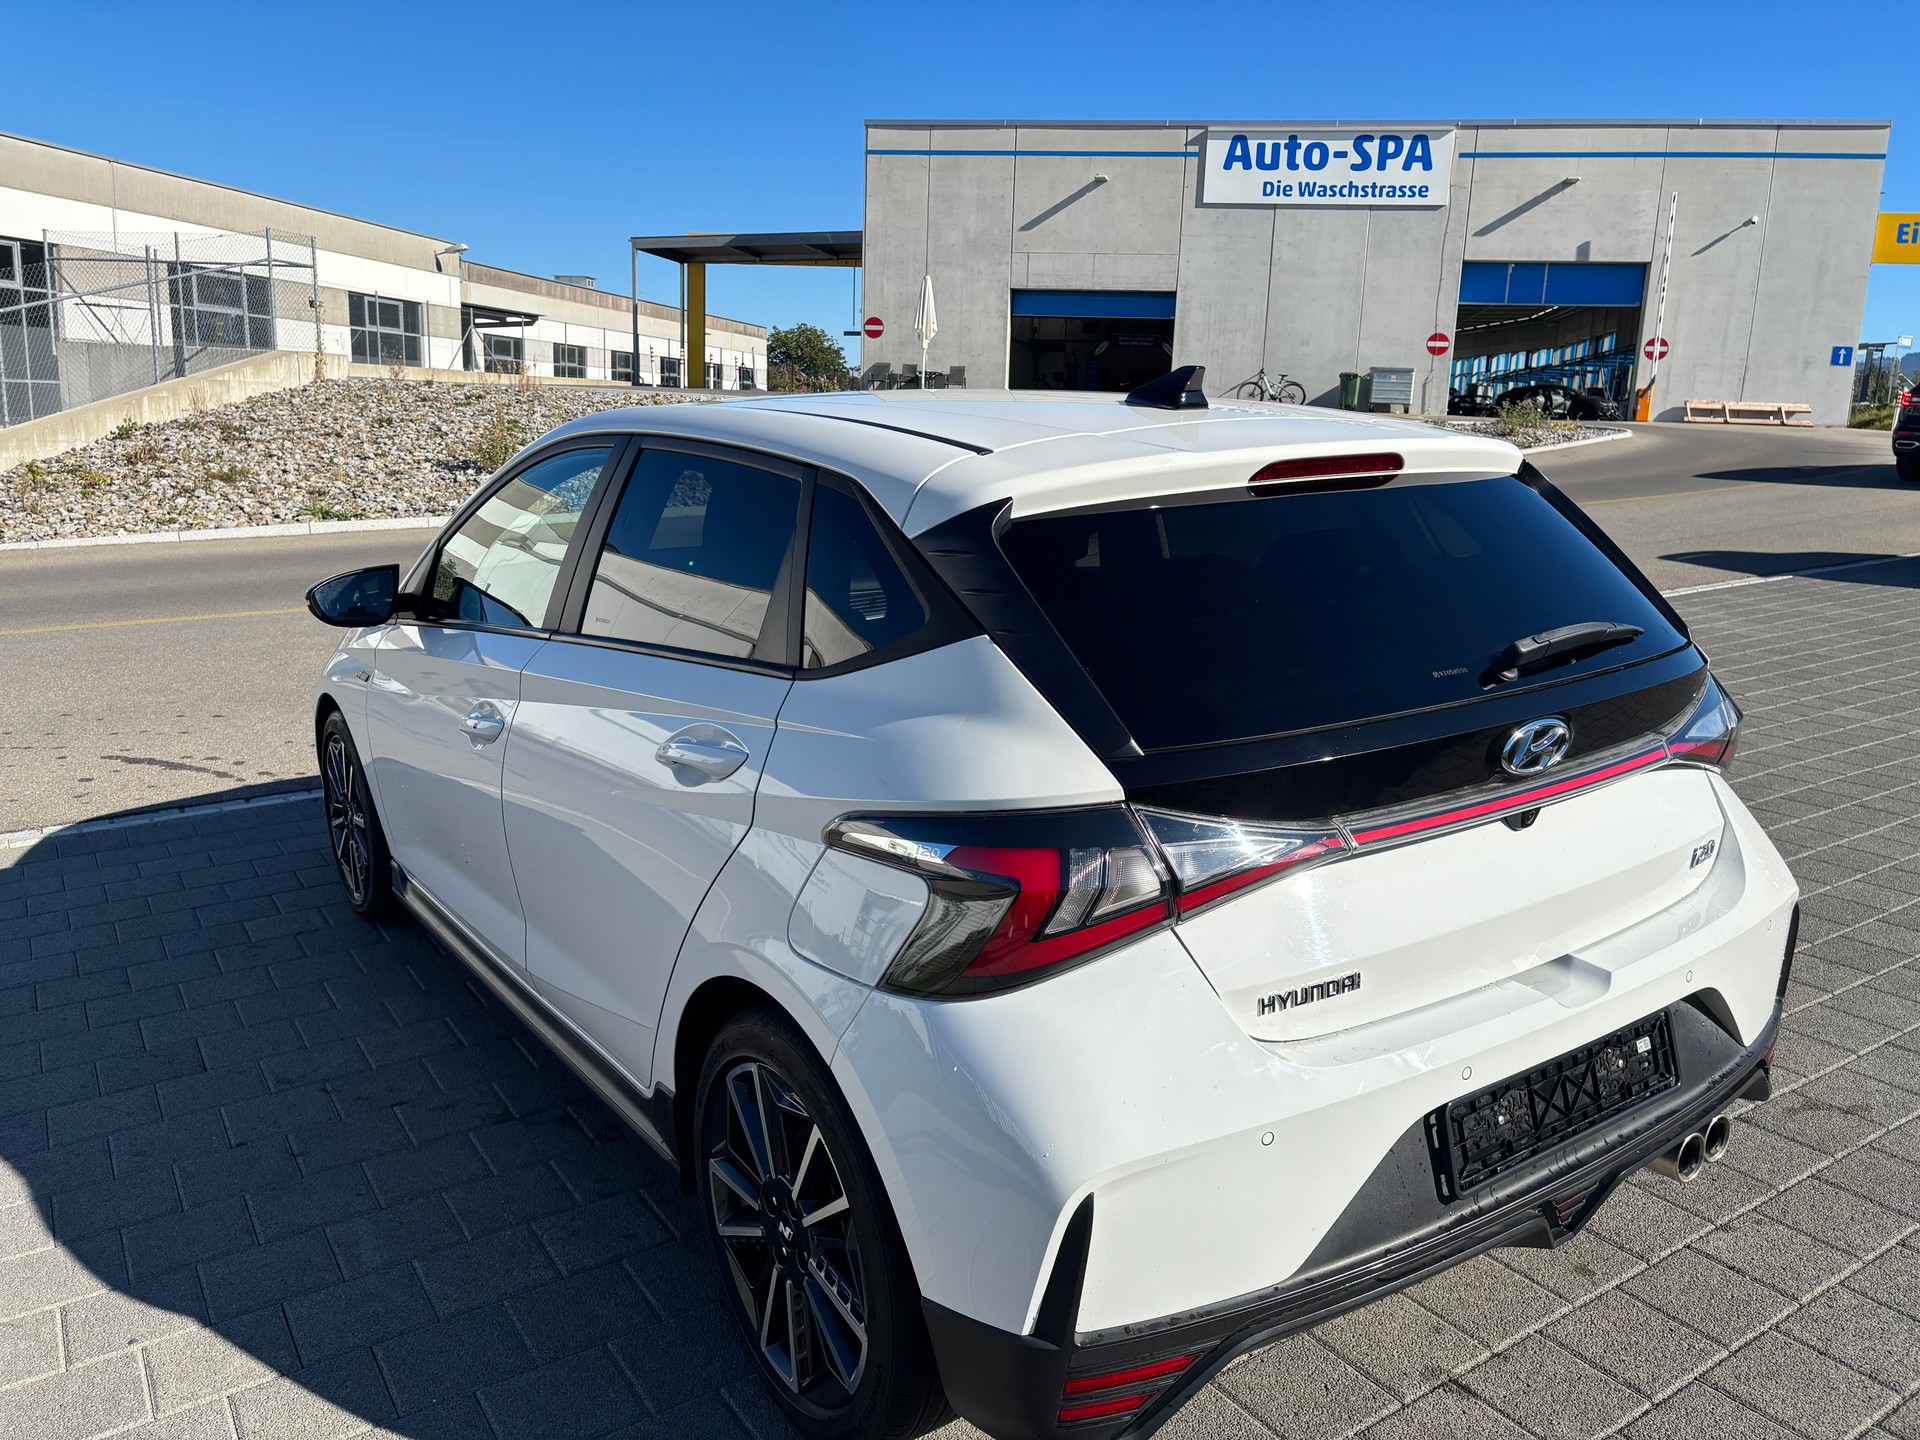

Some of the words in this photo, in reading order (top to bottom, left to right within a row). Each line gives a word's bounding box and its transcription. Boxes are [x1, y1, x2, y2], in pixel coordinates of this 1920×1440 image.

[1222, 134, 1433, 171] Auto-SPA
[1262, 179, 1293, 197] Die
[1298, 180, 1429, 198] Waschstrasse
[1256, 971, 1361, 1017] HYUNDAI
